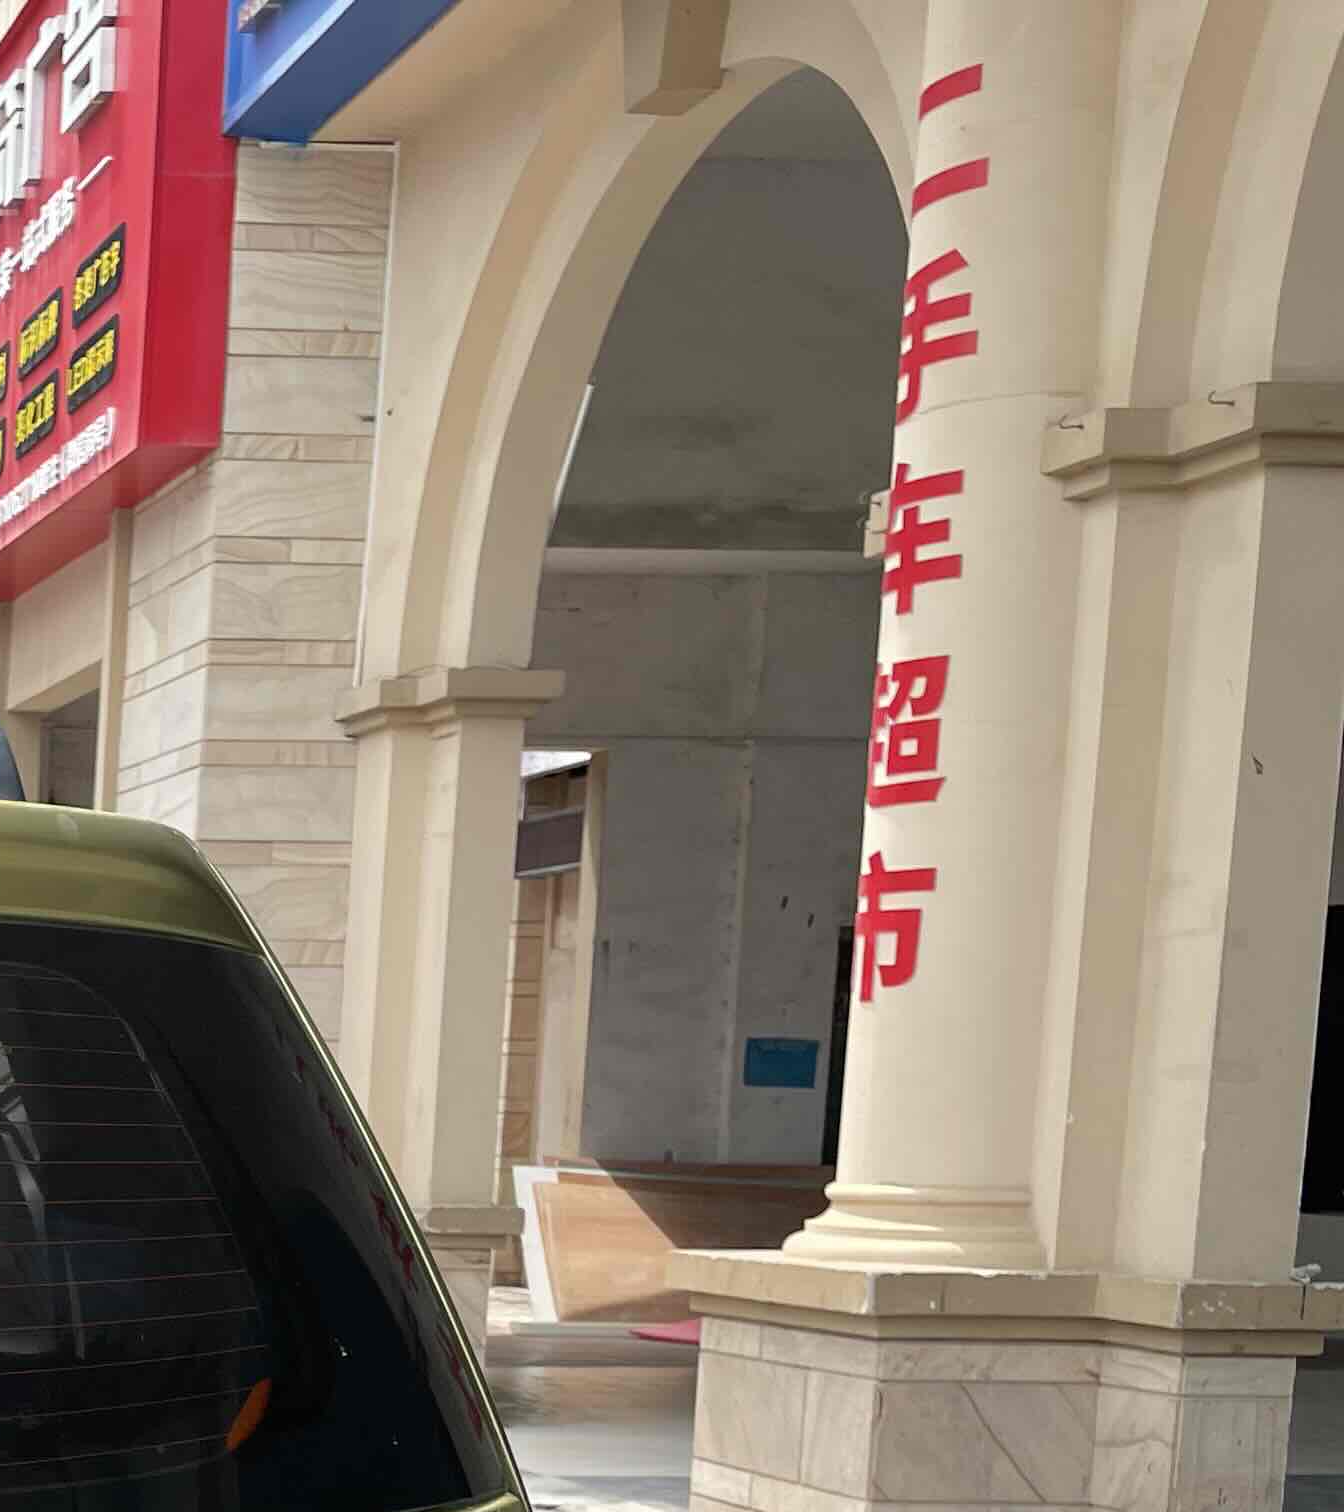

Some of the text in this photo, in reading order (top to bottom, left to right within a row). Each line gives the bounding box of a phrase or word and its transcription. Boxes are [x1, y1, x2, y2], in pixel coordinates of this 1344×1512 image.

[850, 62, 990, 1004] 二手车超市
